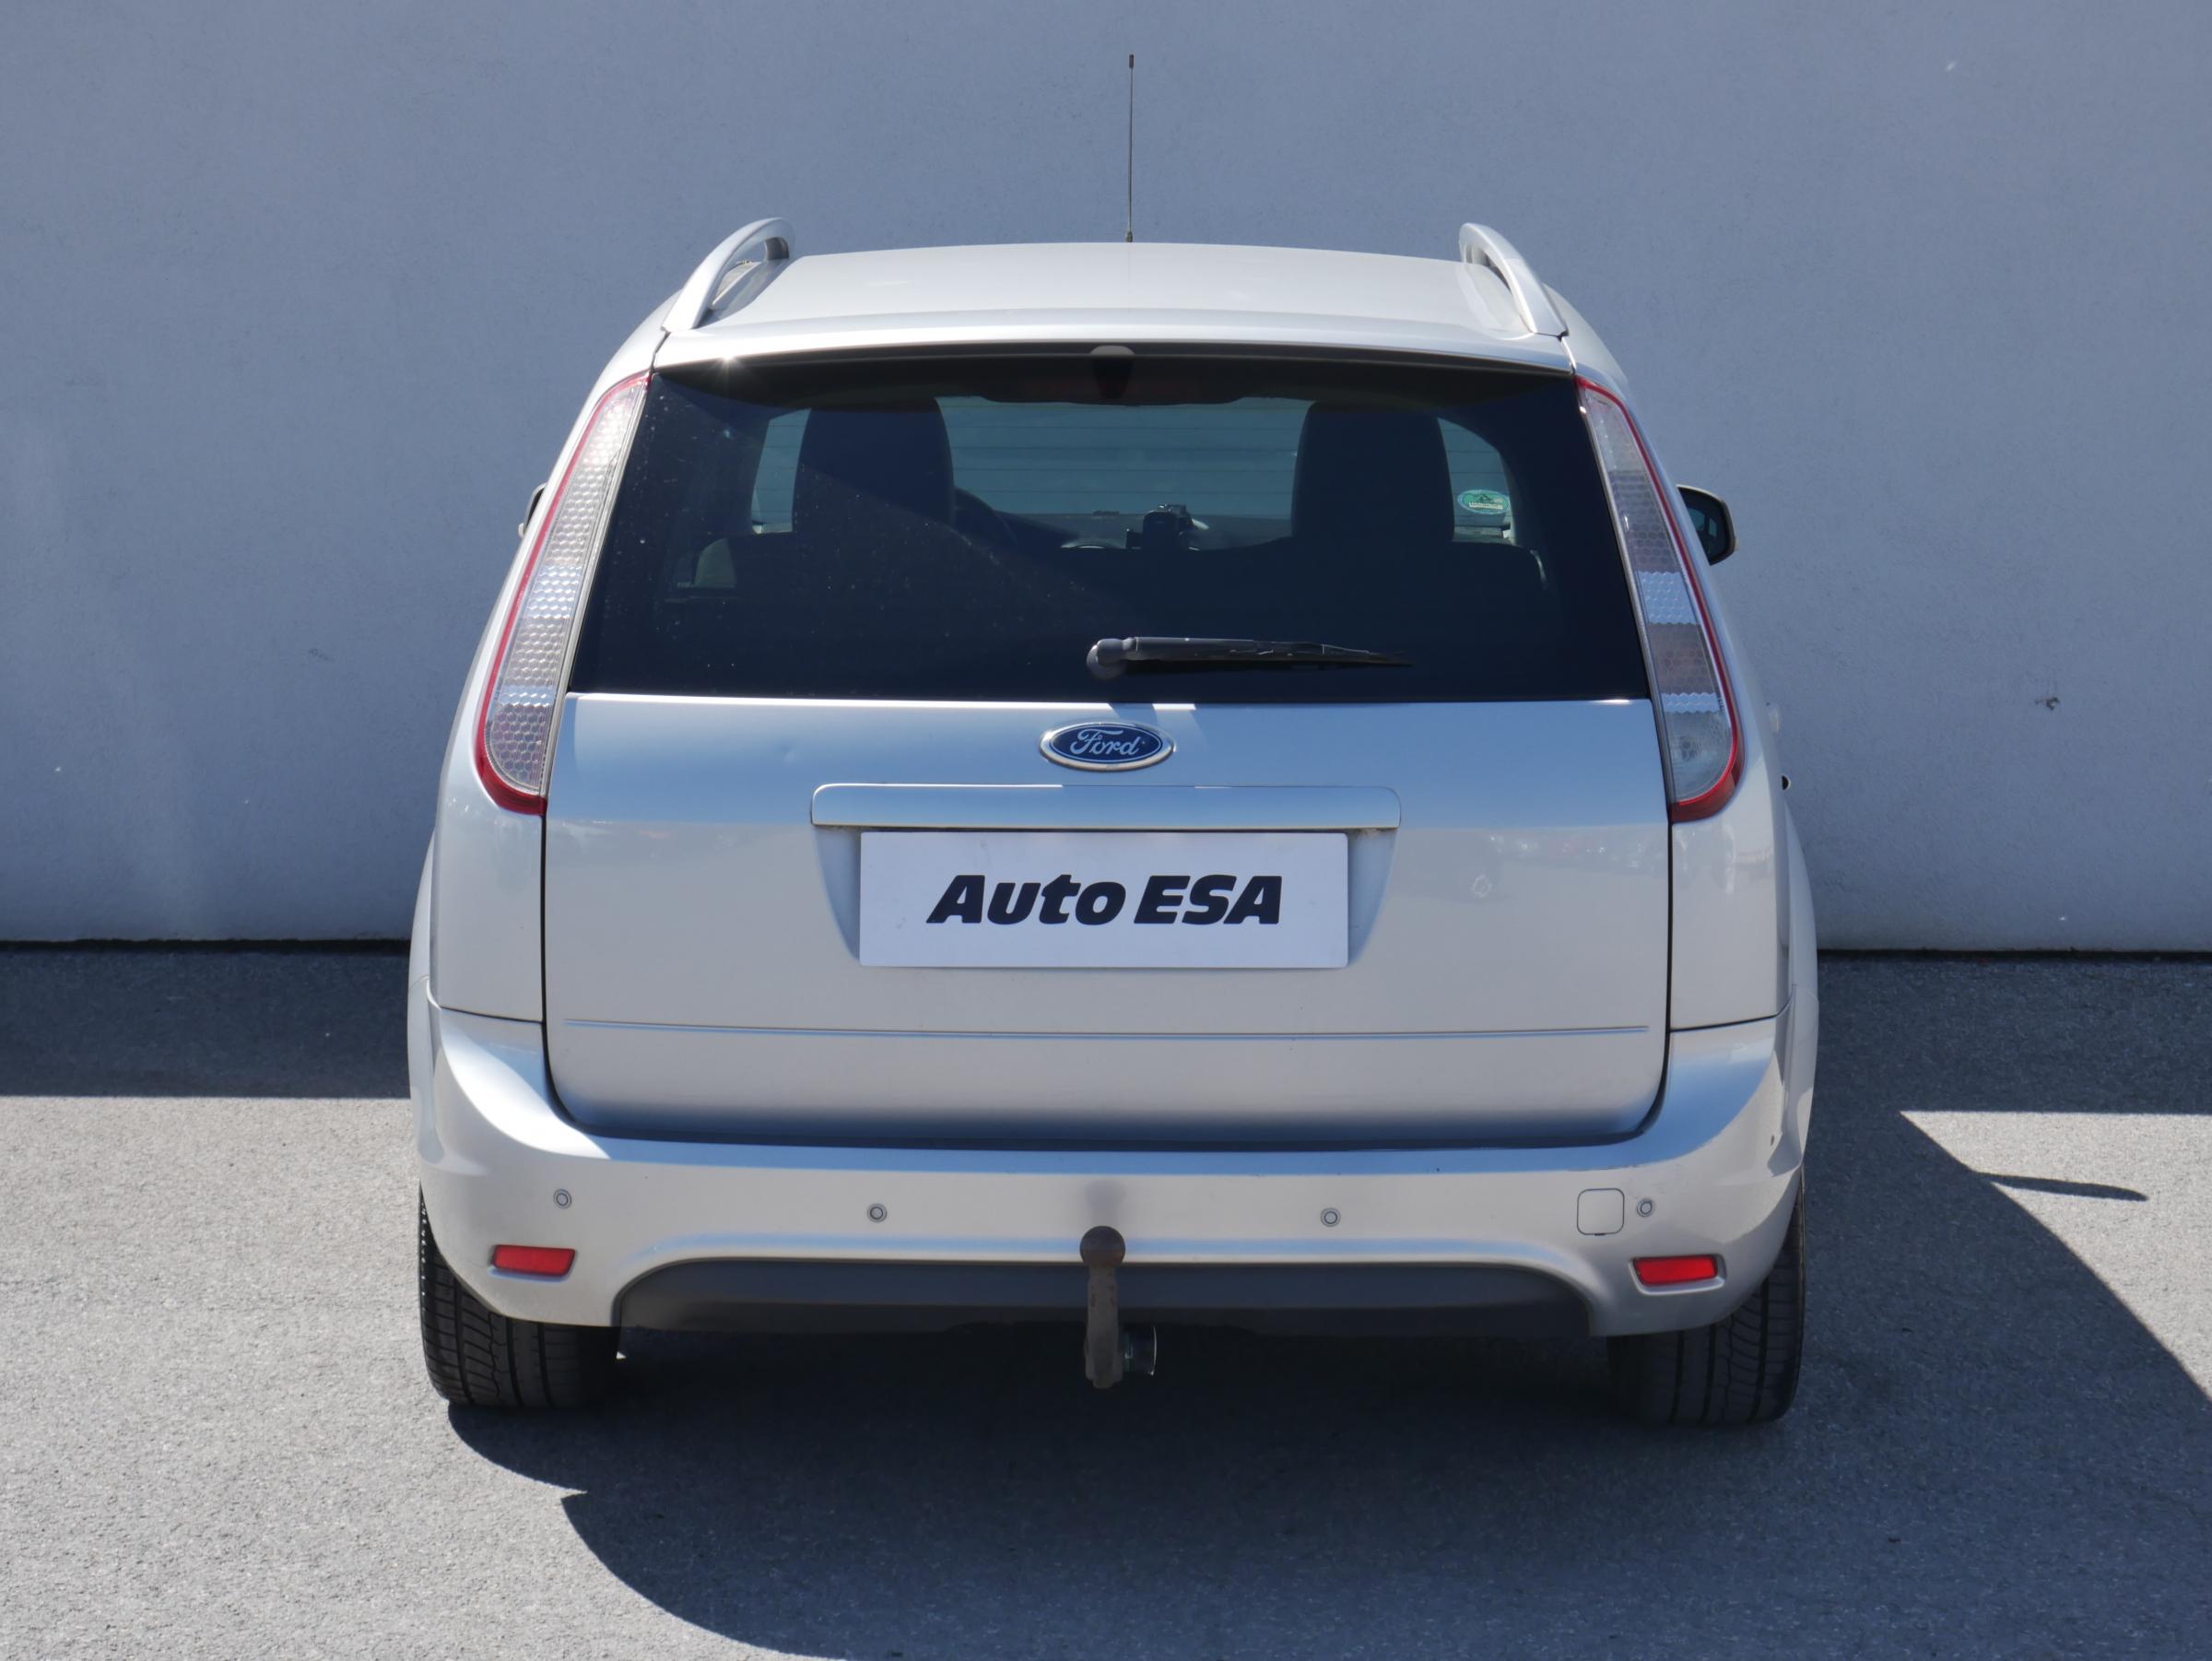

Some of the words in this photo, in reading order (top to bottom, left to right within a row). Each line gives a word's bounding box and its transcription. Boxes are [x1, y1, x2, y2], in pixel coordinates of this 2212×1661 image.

[1070, 728, 1141, 755] Ford
[925, 874, 1127, 925] Auto
[1133, 874, 1283, 925] ESA
